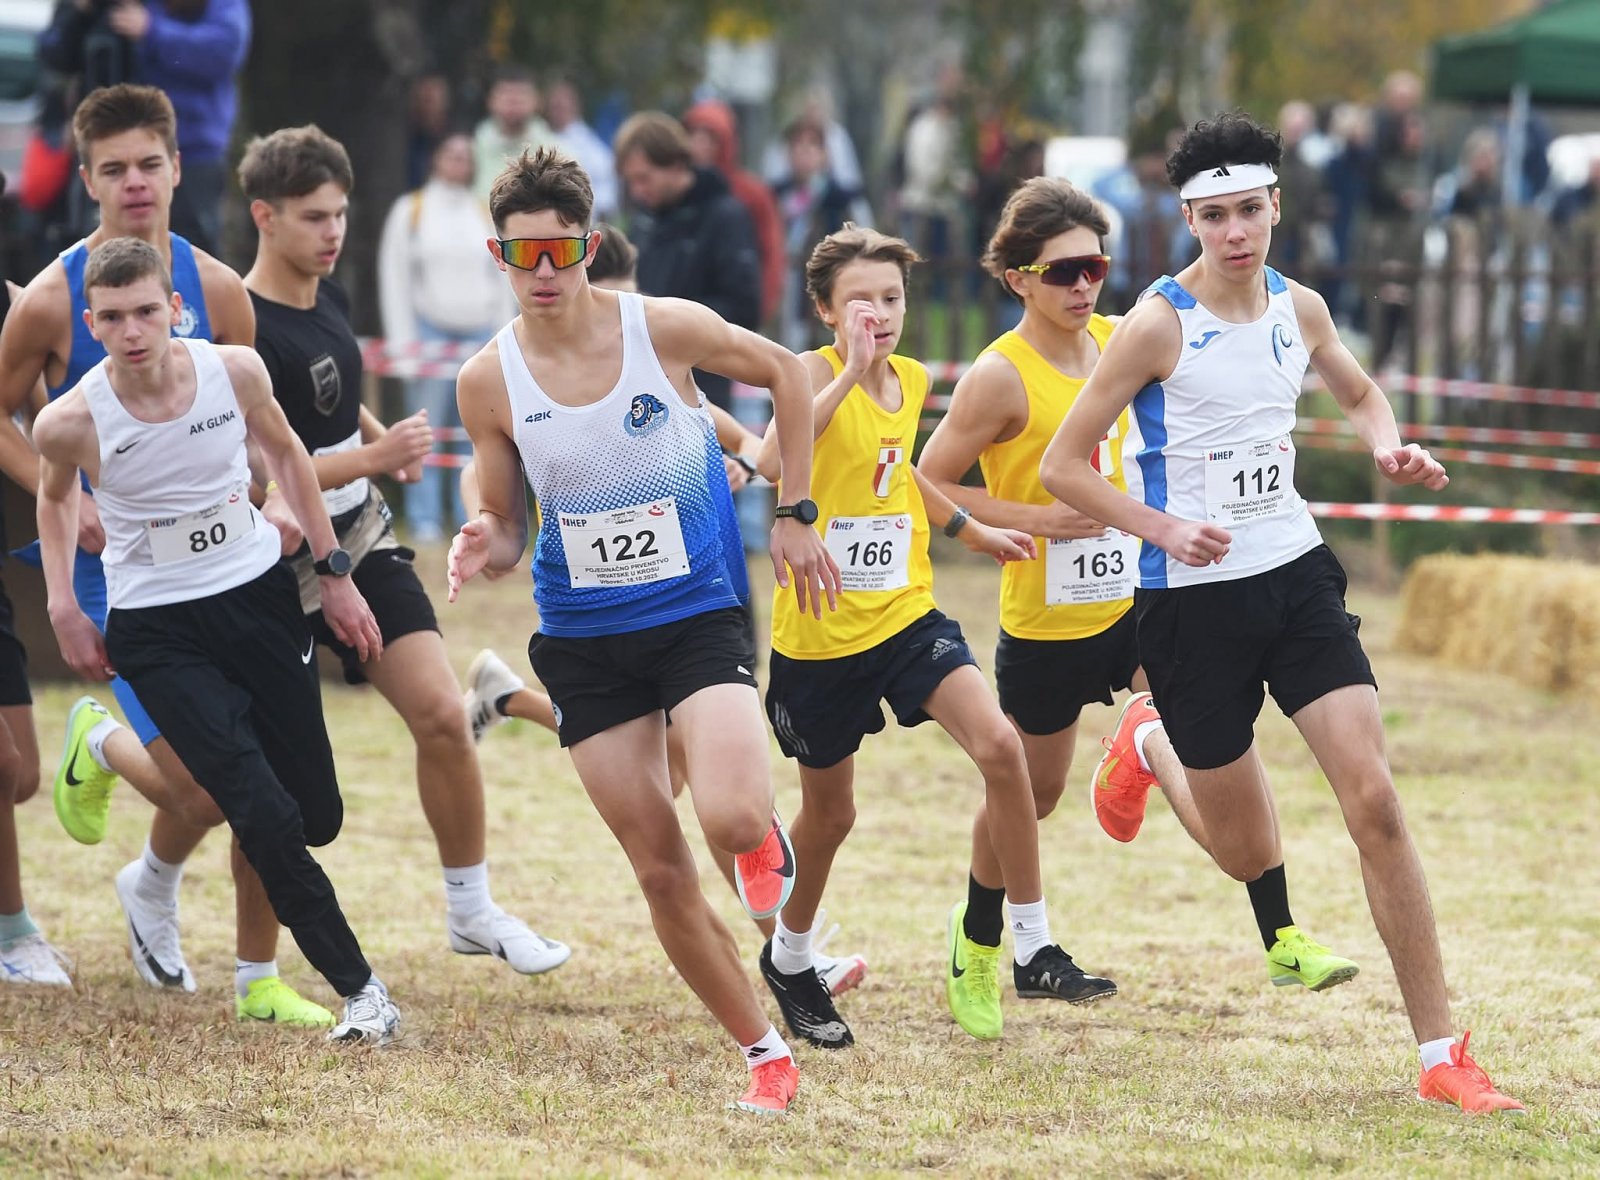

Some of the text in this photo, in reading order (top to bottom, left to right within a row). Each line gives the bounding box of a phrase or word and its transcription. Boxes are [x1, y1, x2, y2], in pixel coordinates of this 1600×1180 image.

[190, 410, 236, 435] AK GLINA
[525, 411, 552, 423] 42K
[1217, 451, 1234, 460] HEP
[1233, 465, 1280, 497] 112
[1222, 501, 1260, 510] POJEDINAČNO
[1231, 506, 1258, 515] HRVATSKE
[159, 518, 177, 528] HEP
[570, 519, 587, 527] HEP
[839, 522, 854, 530] HEP
[189, 522, 227, 553] 80
[591, 530, 659, 563] 122
[847, 540, 893, 567] 166
[584, 557, 669, 573] POJEDINAČNO PRVENSTVO
[1073, 550, 1125, 579] 163
[596, 571, 629, 579] HRVATSKE
[636, 566, 660, 575] KROSU
[931, 643, 959, 661] adidas
